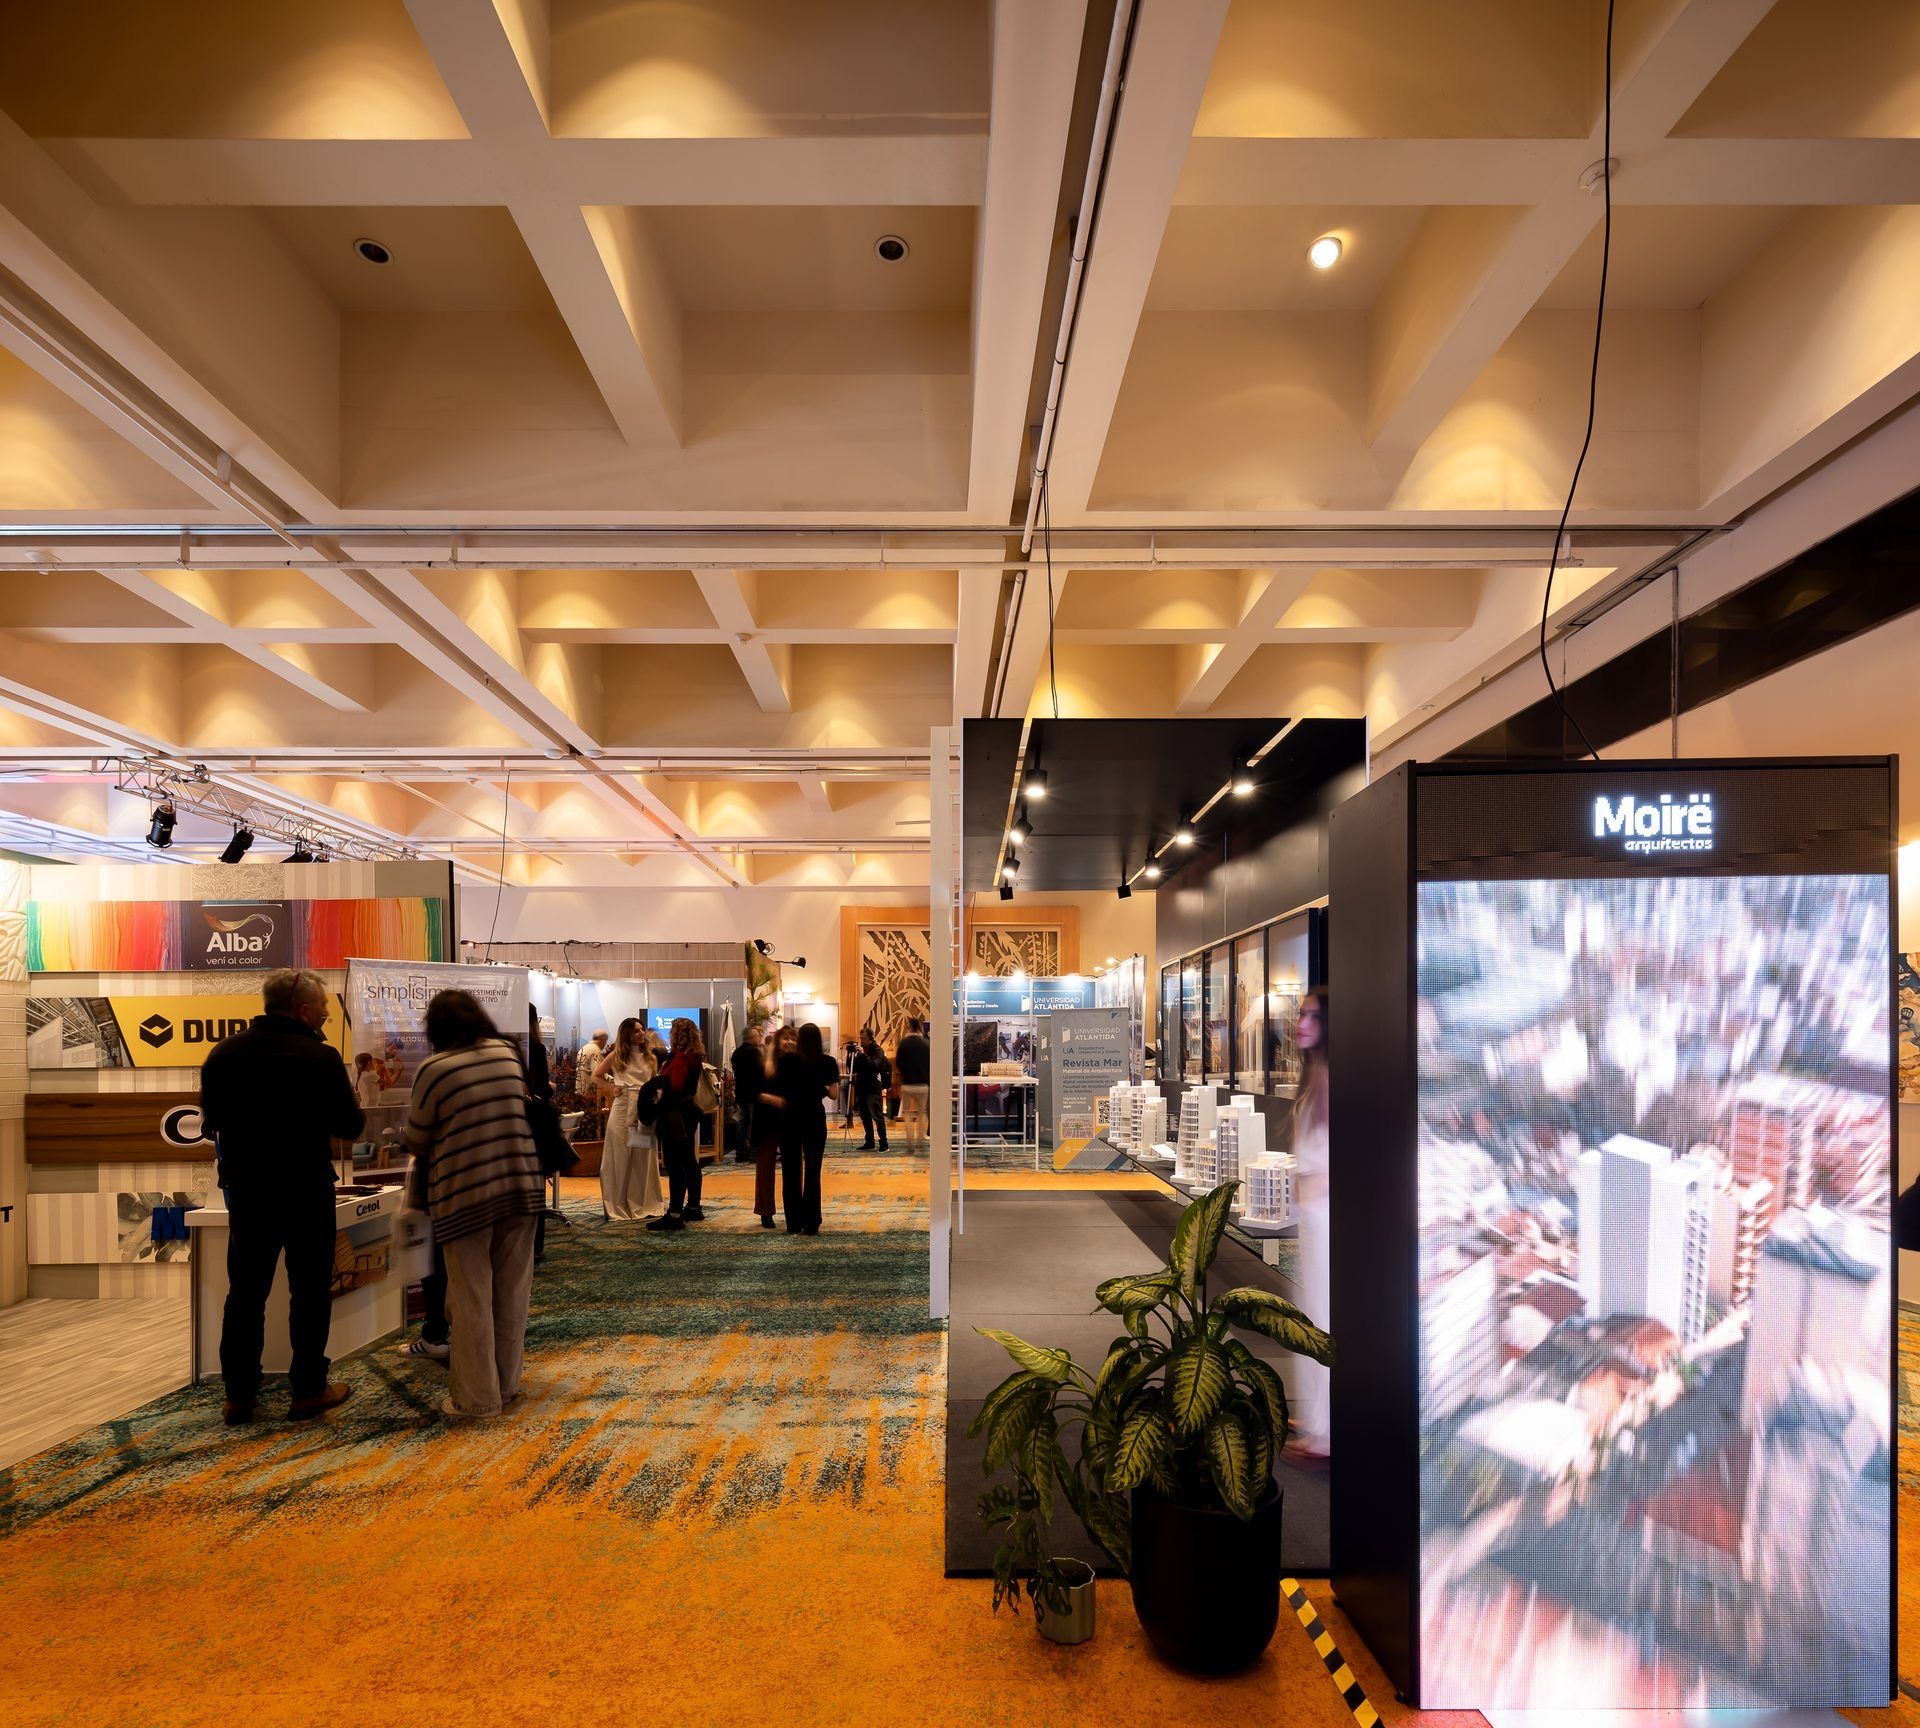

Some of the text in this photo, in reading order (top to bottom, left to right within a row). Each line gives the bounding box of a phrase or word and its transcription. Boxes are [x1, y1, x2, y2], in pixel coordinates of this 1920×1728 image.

[1625, 837, 1713, 854] arquitectos
[206, 932, 263, 952] Alba
[206, 956, 262, 965] vení al color
[1074, 1027, 1120, 1035] UNIVERSIDAD
[1063, 1058, 1122, 1067] Revista Mar
[356, 1200, 380, 1217] Cetol
